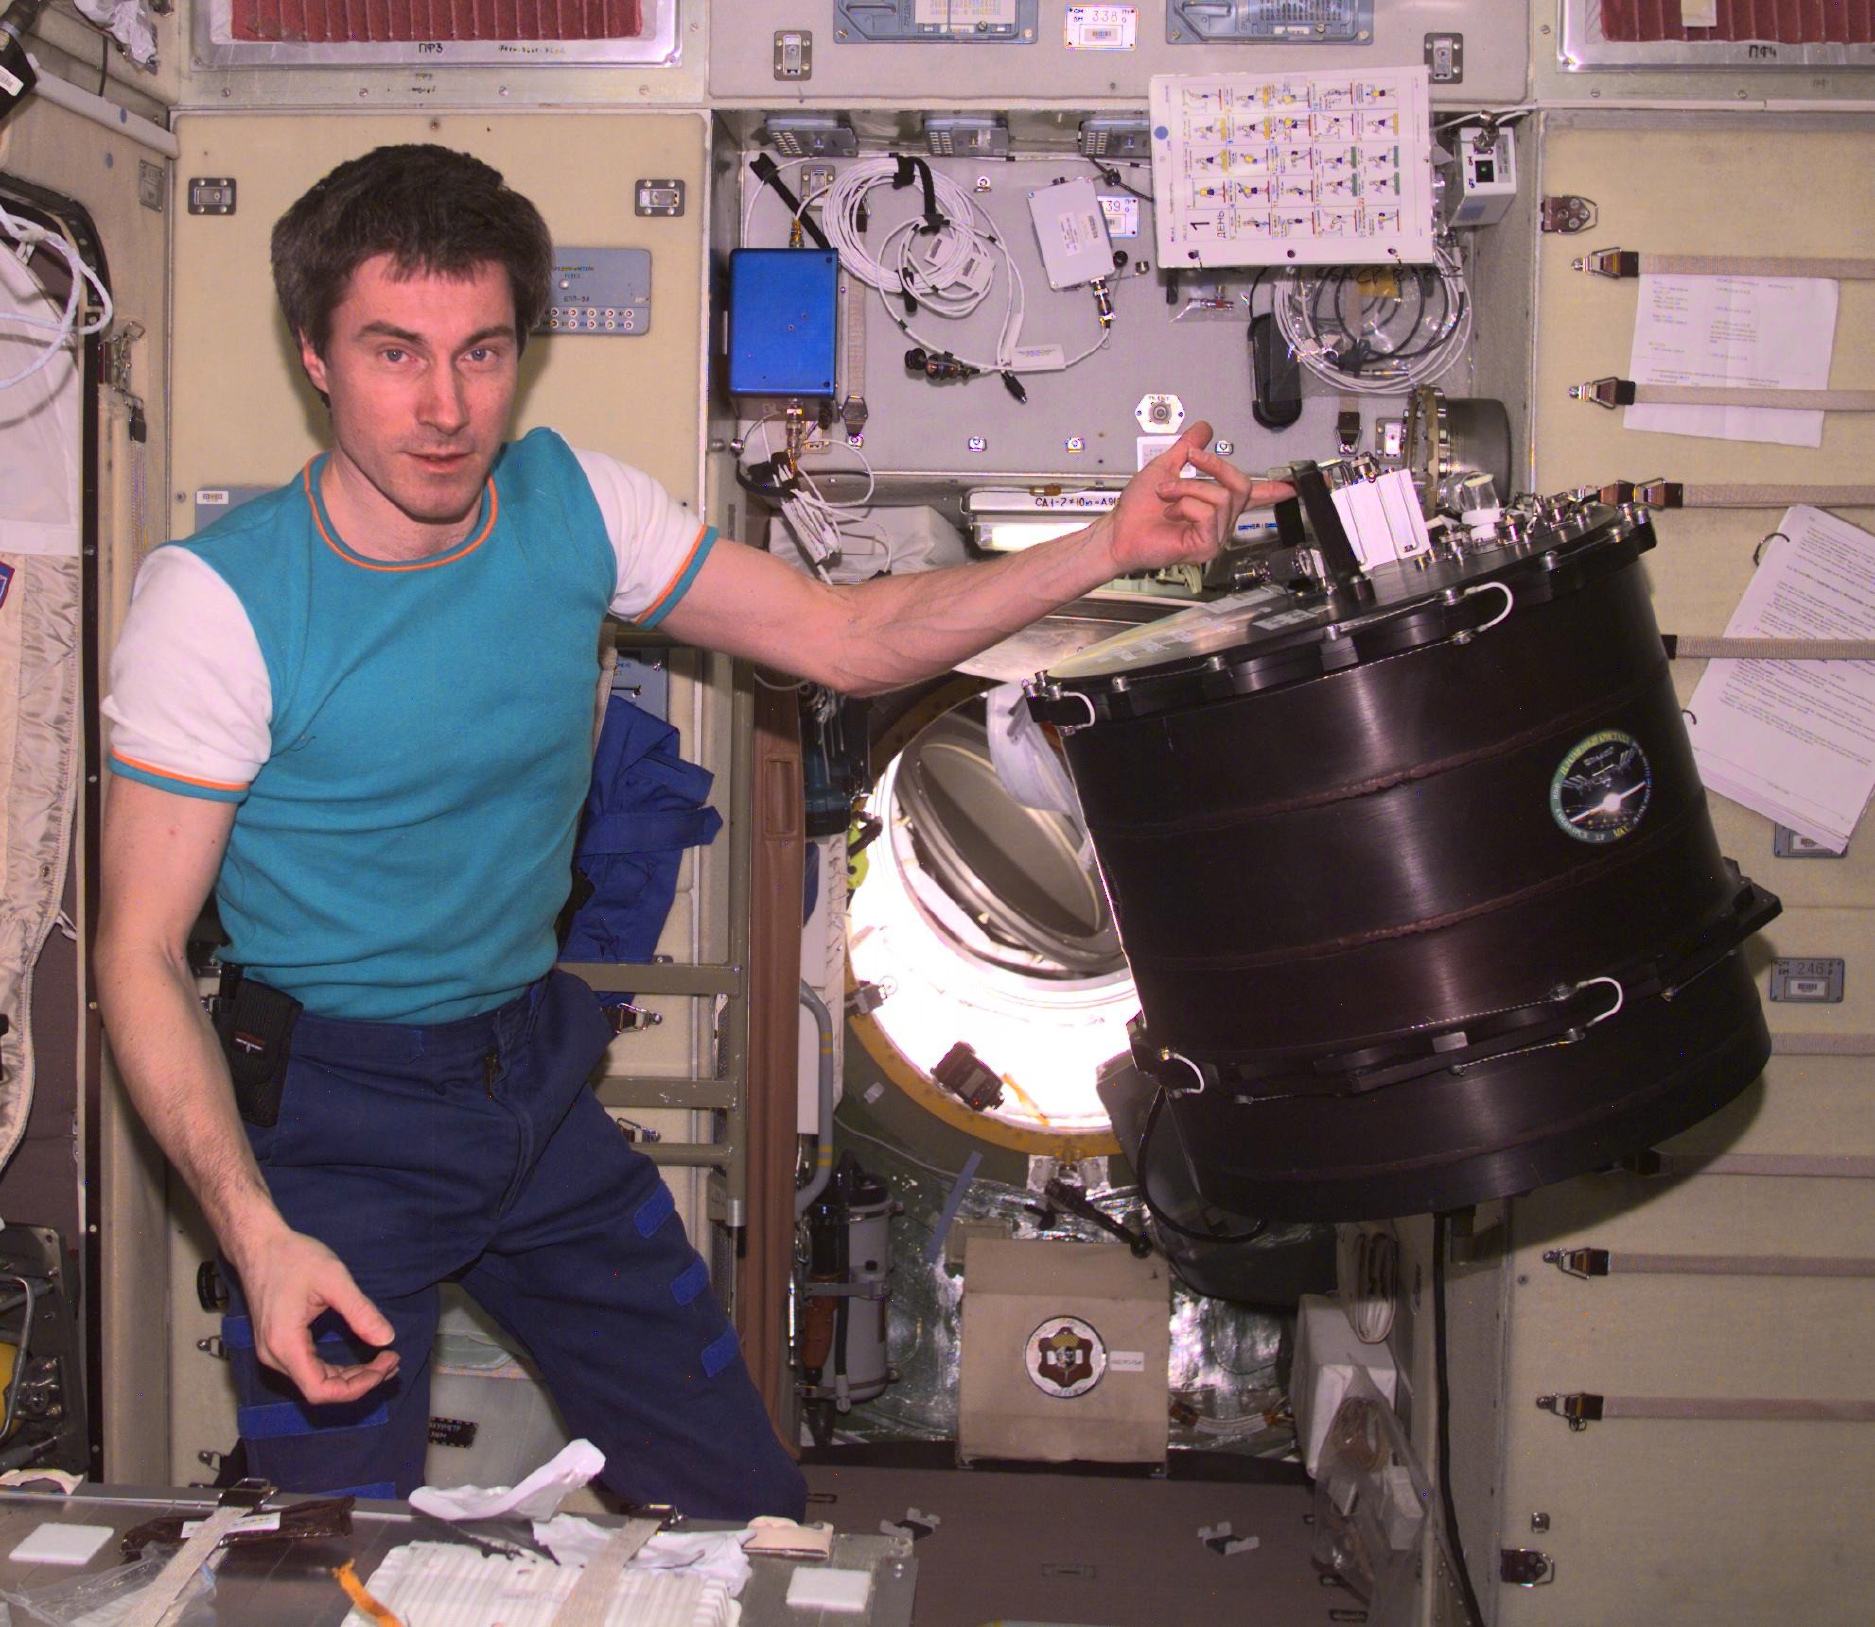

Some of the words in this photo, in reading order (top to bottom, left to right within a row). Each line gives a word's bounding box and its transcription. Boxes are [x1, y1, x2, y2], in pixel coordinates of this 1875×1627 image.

[1092, 10, 1118, 22] 338
[1216, 210, 1227, 239] ДЕНЬ
[1797, 962, 1824, 975] 246
